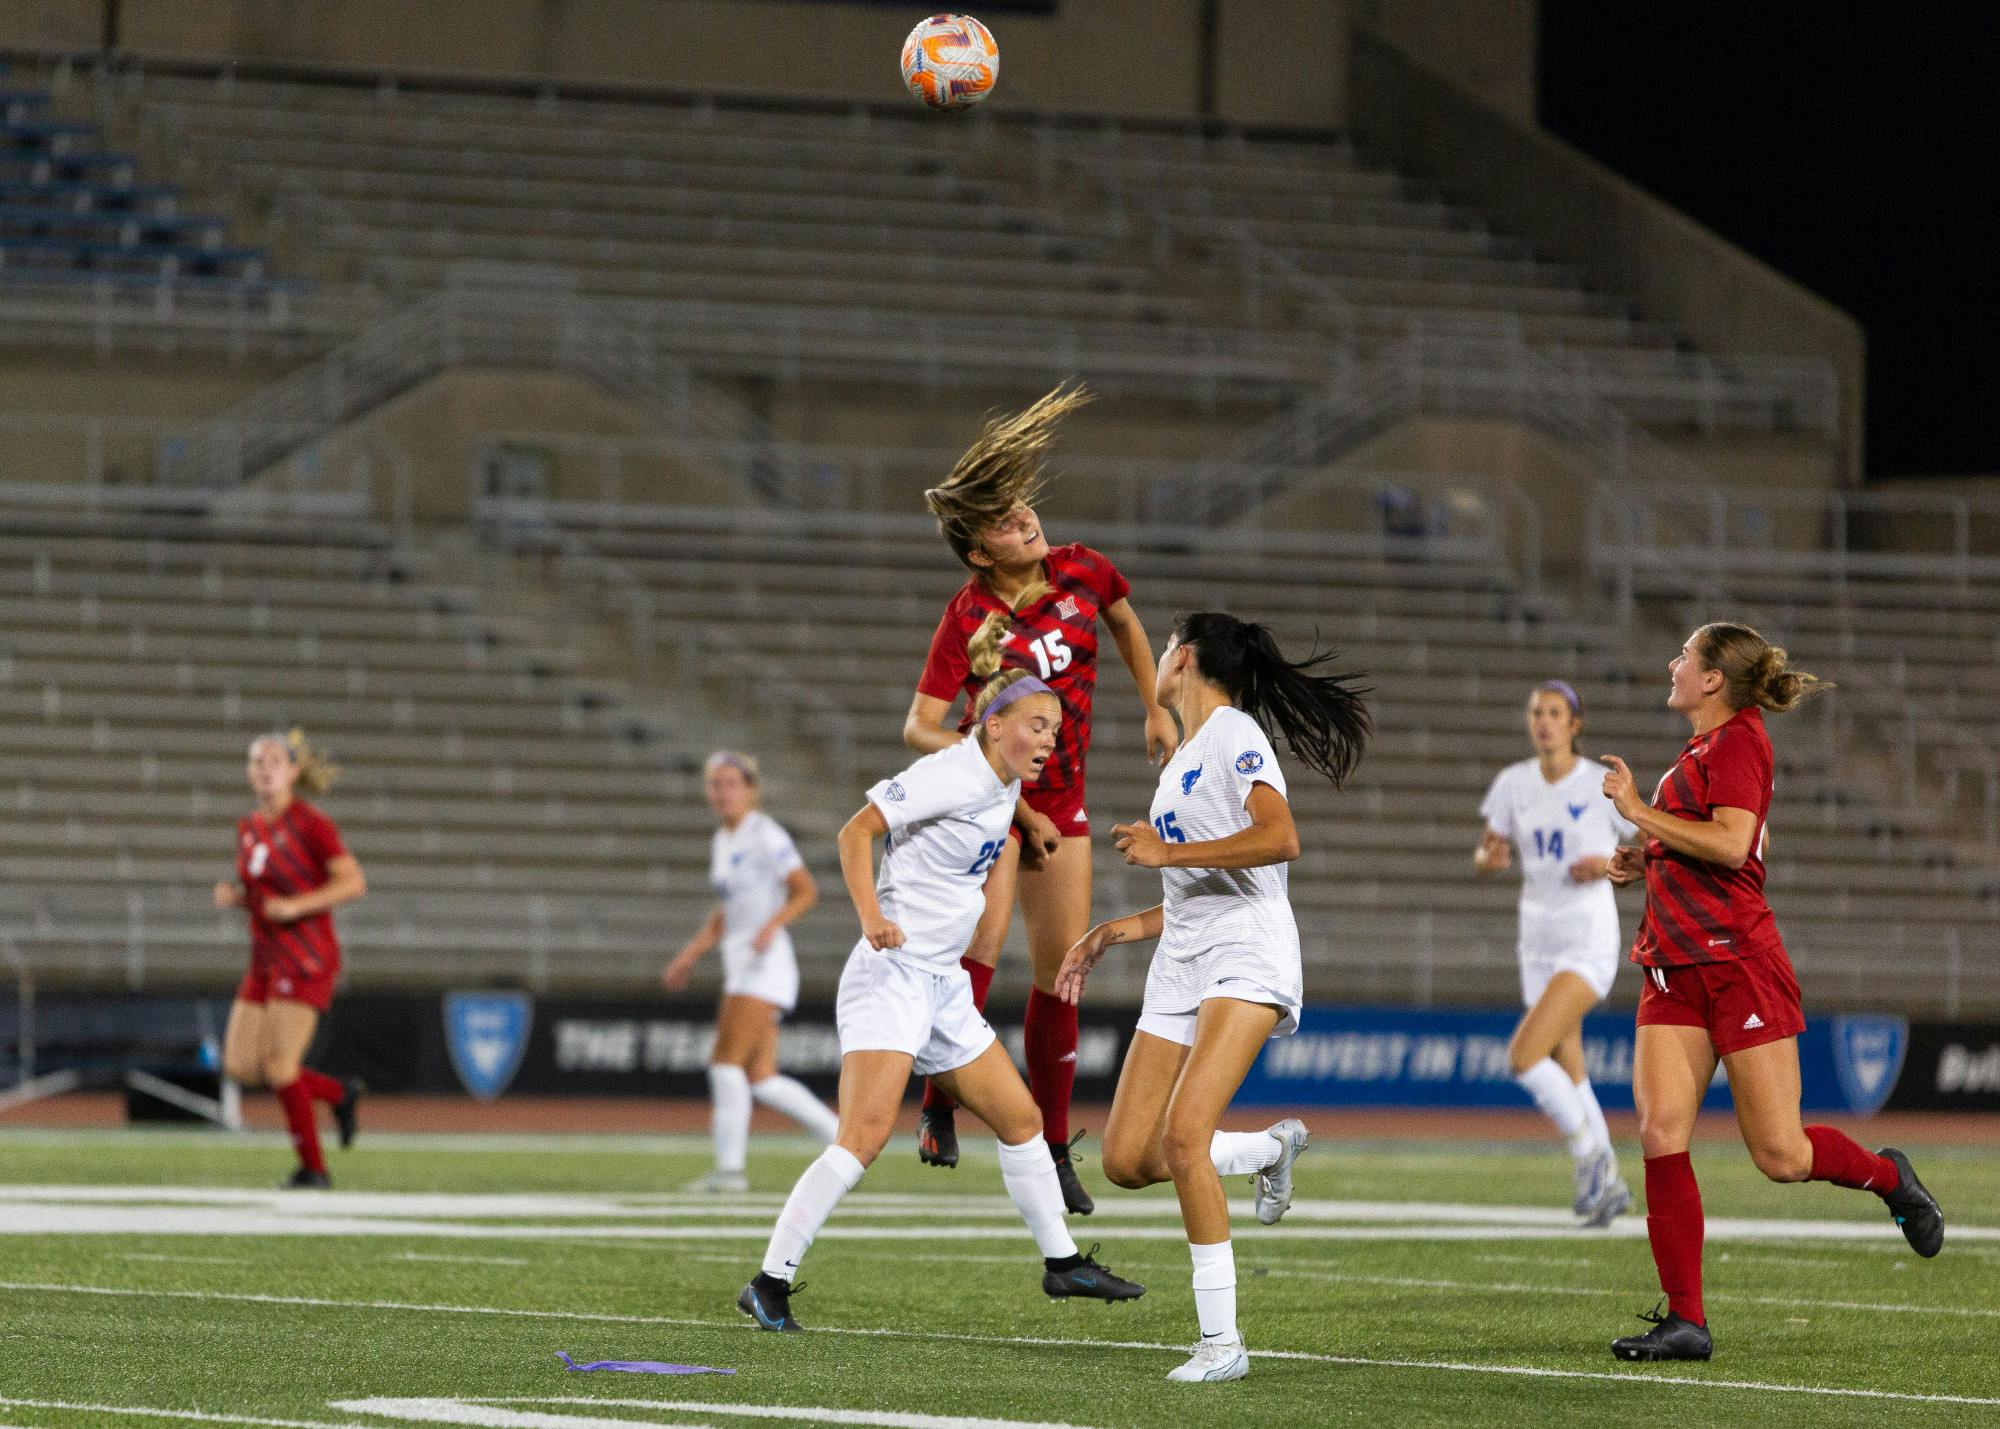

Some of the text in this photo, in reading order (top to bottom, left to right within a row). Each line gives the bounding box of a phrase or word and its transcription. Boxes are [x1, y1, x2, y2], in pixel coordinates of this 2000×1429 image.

[1029, 628, 1072, 680] 15
[1154, 811, 1186, 843] 15
[1533, 829, 1564, 861] 14
[1266, 1033, 1514, 1082] INVEST IN TH
